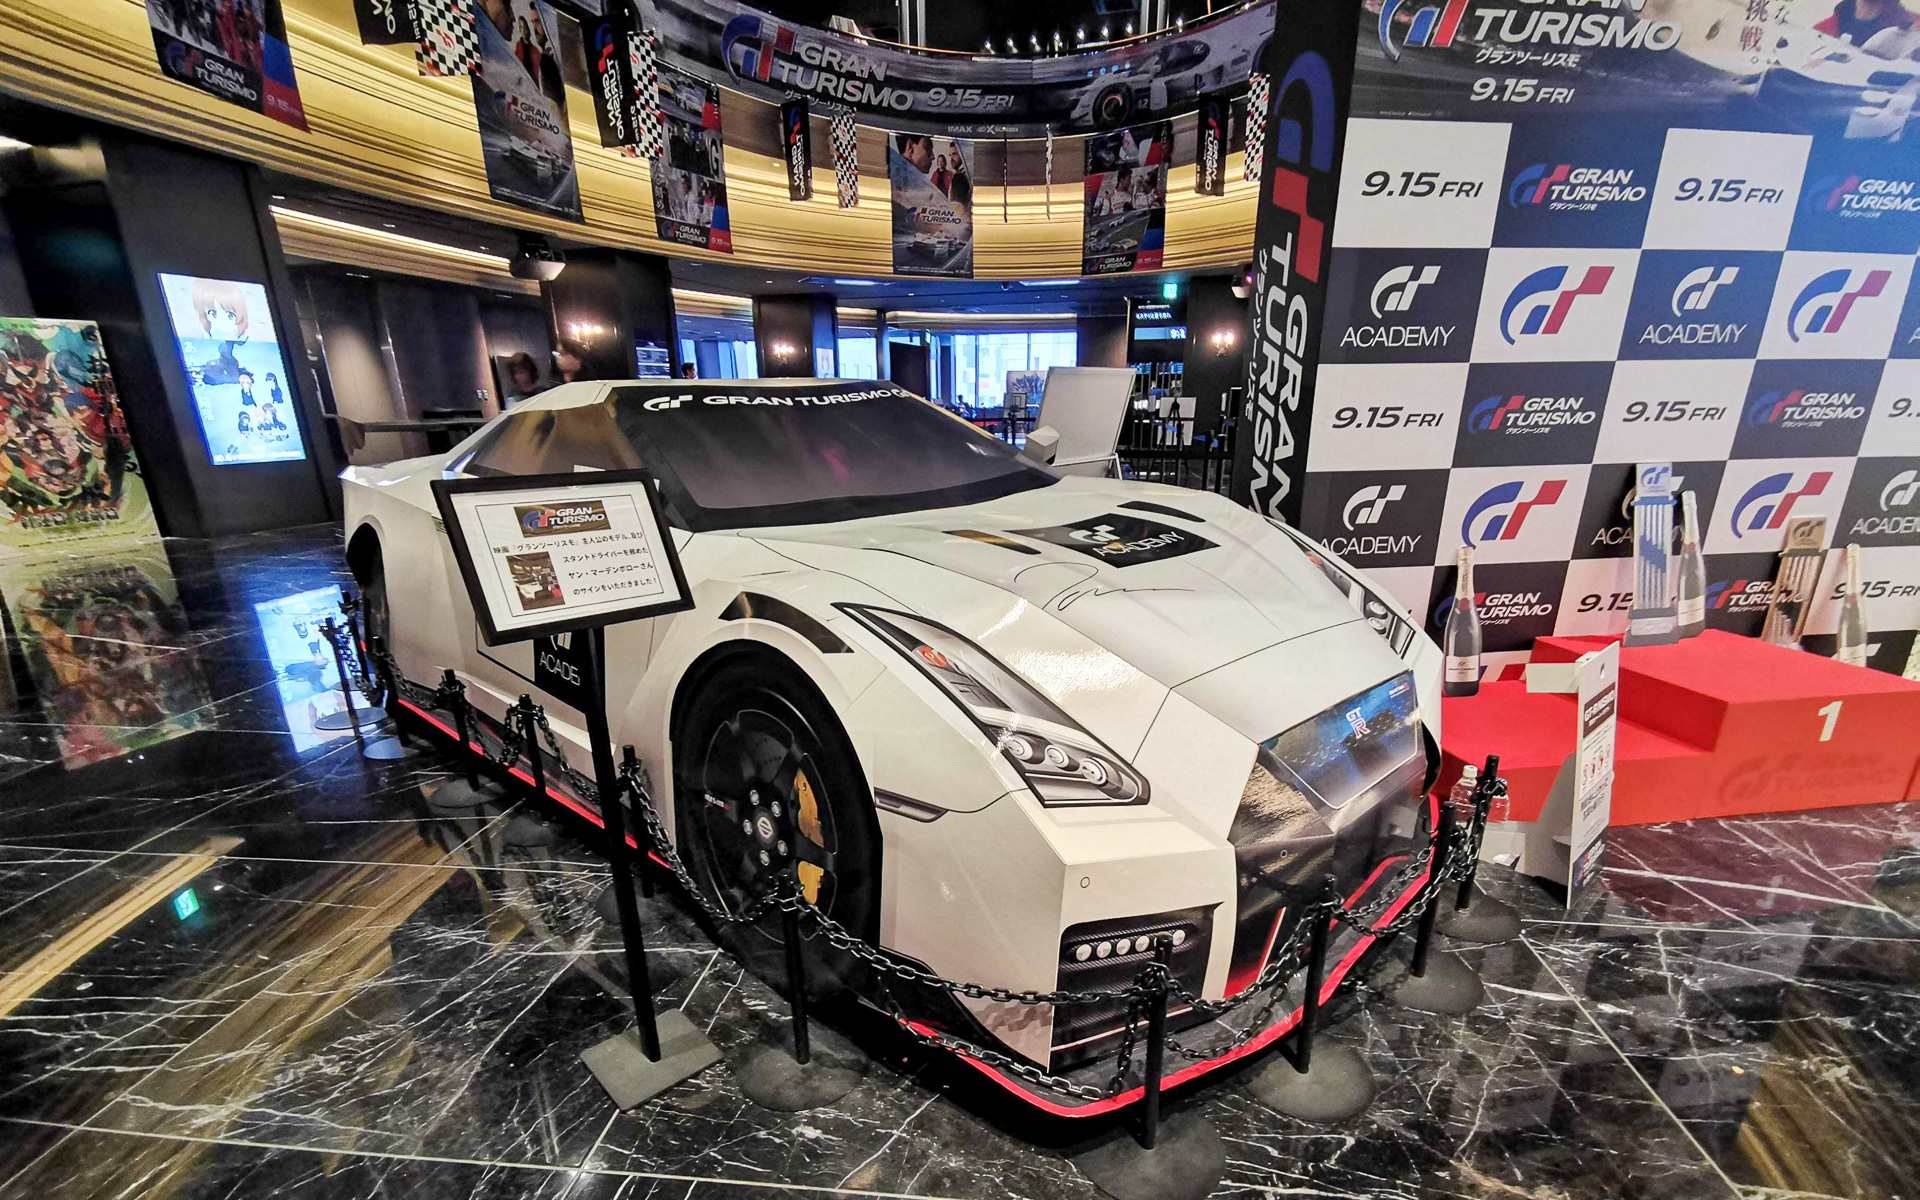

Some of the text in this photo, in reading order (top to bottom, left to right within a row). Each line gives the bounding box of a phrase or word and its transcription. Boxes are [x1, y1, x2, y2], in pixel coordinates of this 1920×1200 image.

[1474, 8, 1684, 51] TURISMO
[799, 42, 889, 82] GRAN
[1475, 47, 1581, 67] グランツーリスモ
[205, 58, 245, 84] GRAN
[195, 66, 257, 101] TURISMO
[778, 60, 1015, 111] TURISMO 9.15 FRI
[1469, 77, 1577, 104] 9.15 FRI
[514, 108, 560, 135] TURISMO
[520, 102, 552, 121] GRAN
[947, 125, 974, 134] IMAX
[1204, 129, 1215, 191] TURISMO
[1211, 140, 1219, 180] GRAN
[1361, 170, 1485, 199] 9.15 FRI
[1569, 167, 1634, 186] GRAN
[1857, 178, 1916, 195] GRAN
[1550, 184, 1647, 202] TURISMO
[1674, 177, 1784, 204] 9.15 FRI
[921, 215, 962, 225] TURISMO
[928, 208, 955, 218] GRAN
[675, 230, 707, 244] TURISMO
[680, 225, 701, 236] GRAN
[1104, 256, 1126, 264] GRAN
[1340, 325, 1456, 347] ACADEMY
[1639, 323, 1748, 345] ACADEMY
[1249, 232, 1293, 518] TURISM
[703, 395, 794, 406] GRAN
[794, 388, 892, 407] TURISMO
[1523, 397, 1584, 411] GRAN
[1800, 392, 1856, 405] GRAN
[1269, 294, 1309, 523] GRAN
[1332, 406, 1444, 429] 9.15 FRI
[1505, 411, 1597, 426] TURISMO
[1622, 400, 1728, 423] 9.15 FRI
[1783, 405, 1866, 420] TURISMO
[548, 513, 605, 526] TURISMO
[555, 506, 593, 516] GRAN
[1485, 592, 1541, 606] GRAN
[1818, 700, 1844, 742] 1
